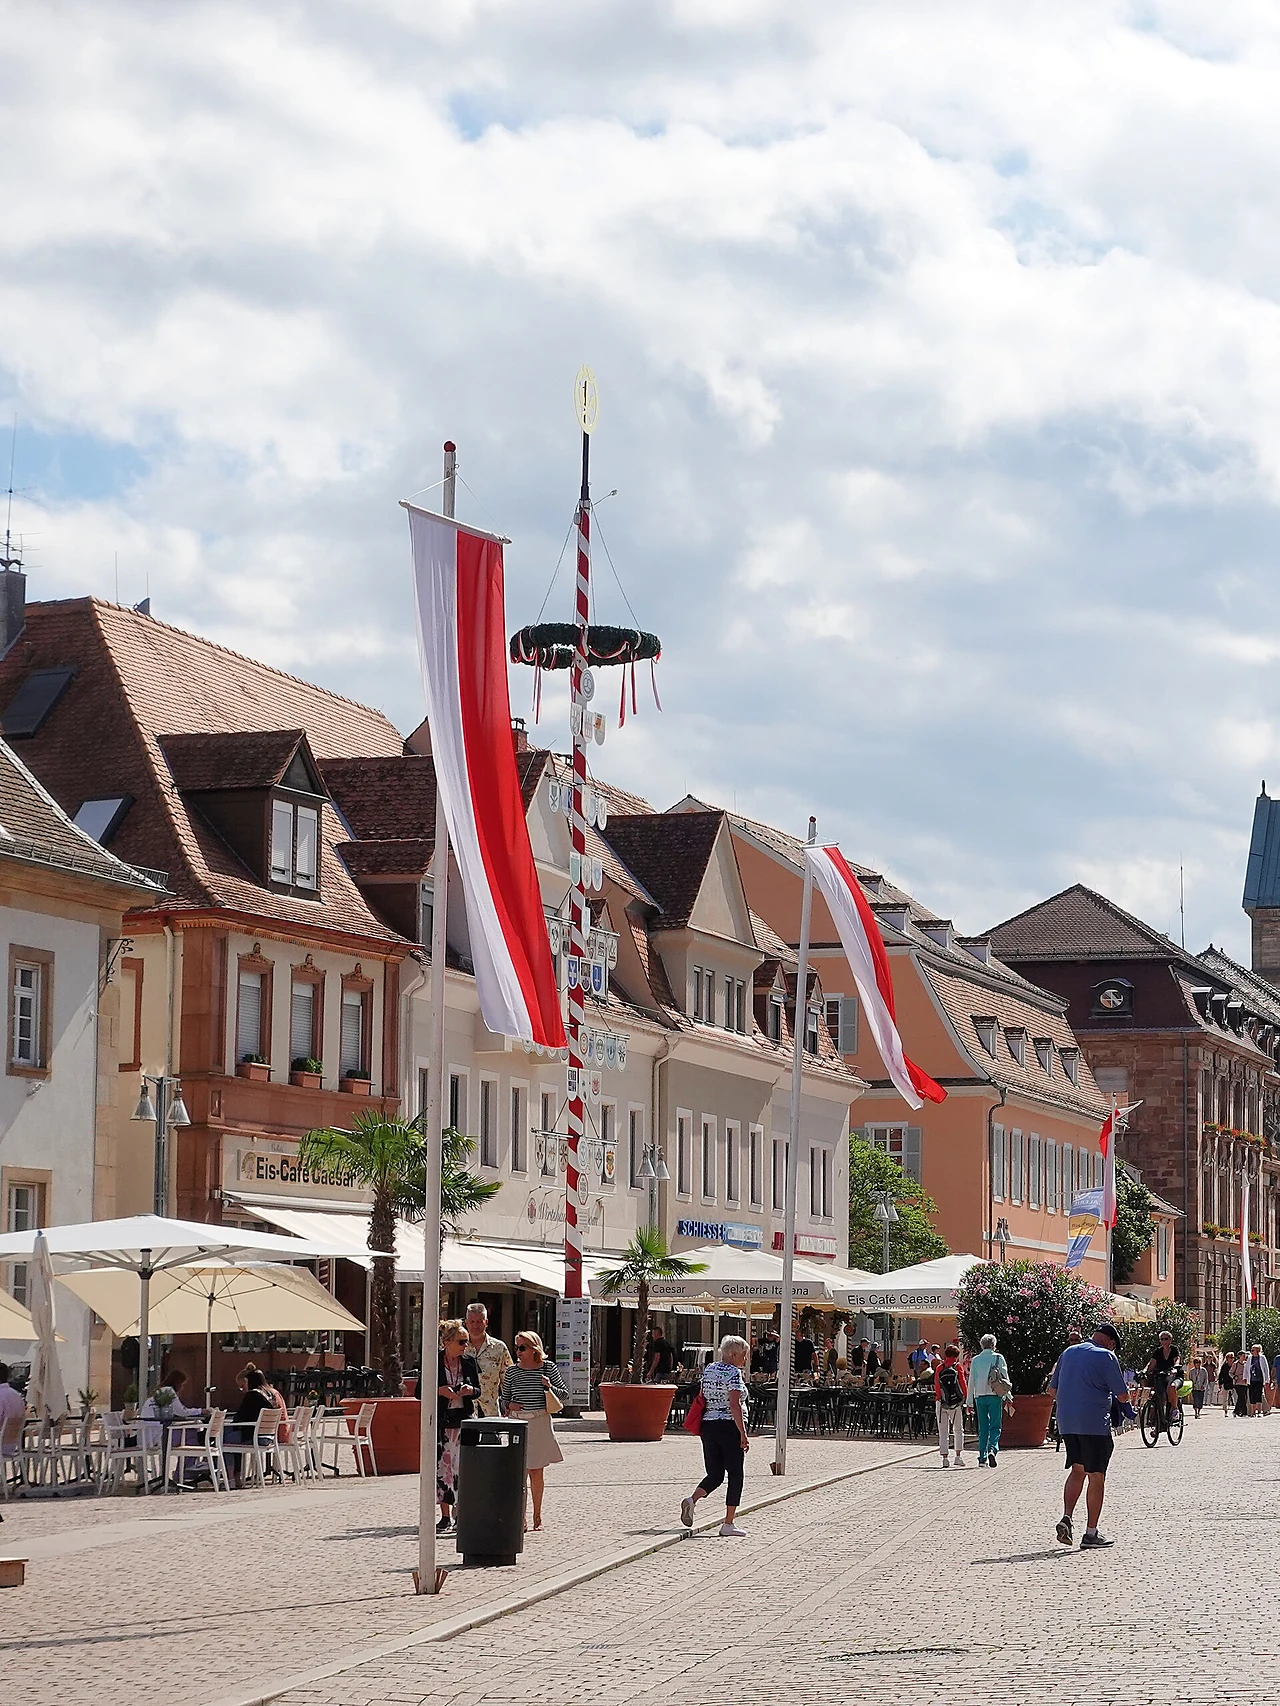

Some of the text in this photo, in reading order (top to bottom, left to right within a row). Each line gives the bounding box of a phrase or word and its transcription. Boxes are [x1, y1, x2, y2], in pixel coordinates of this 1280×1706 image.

[682, 1220, 727, 1241] SCHIESSER
[652, 1284, 686, 1294] Caesar
[722, 1284, 809, 1296] Gelateria Itaana
[847, 1293, 941, 1306] Eis Café Caesar
